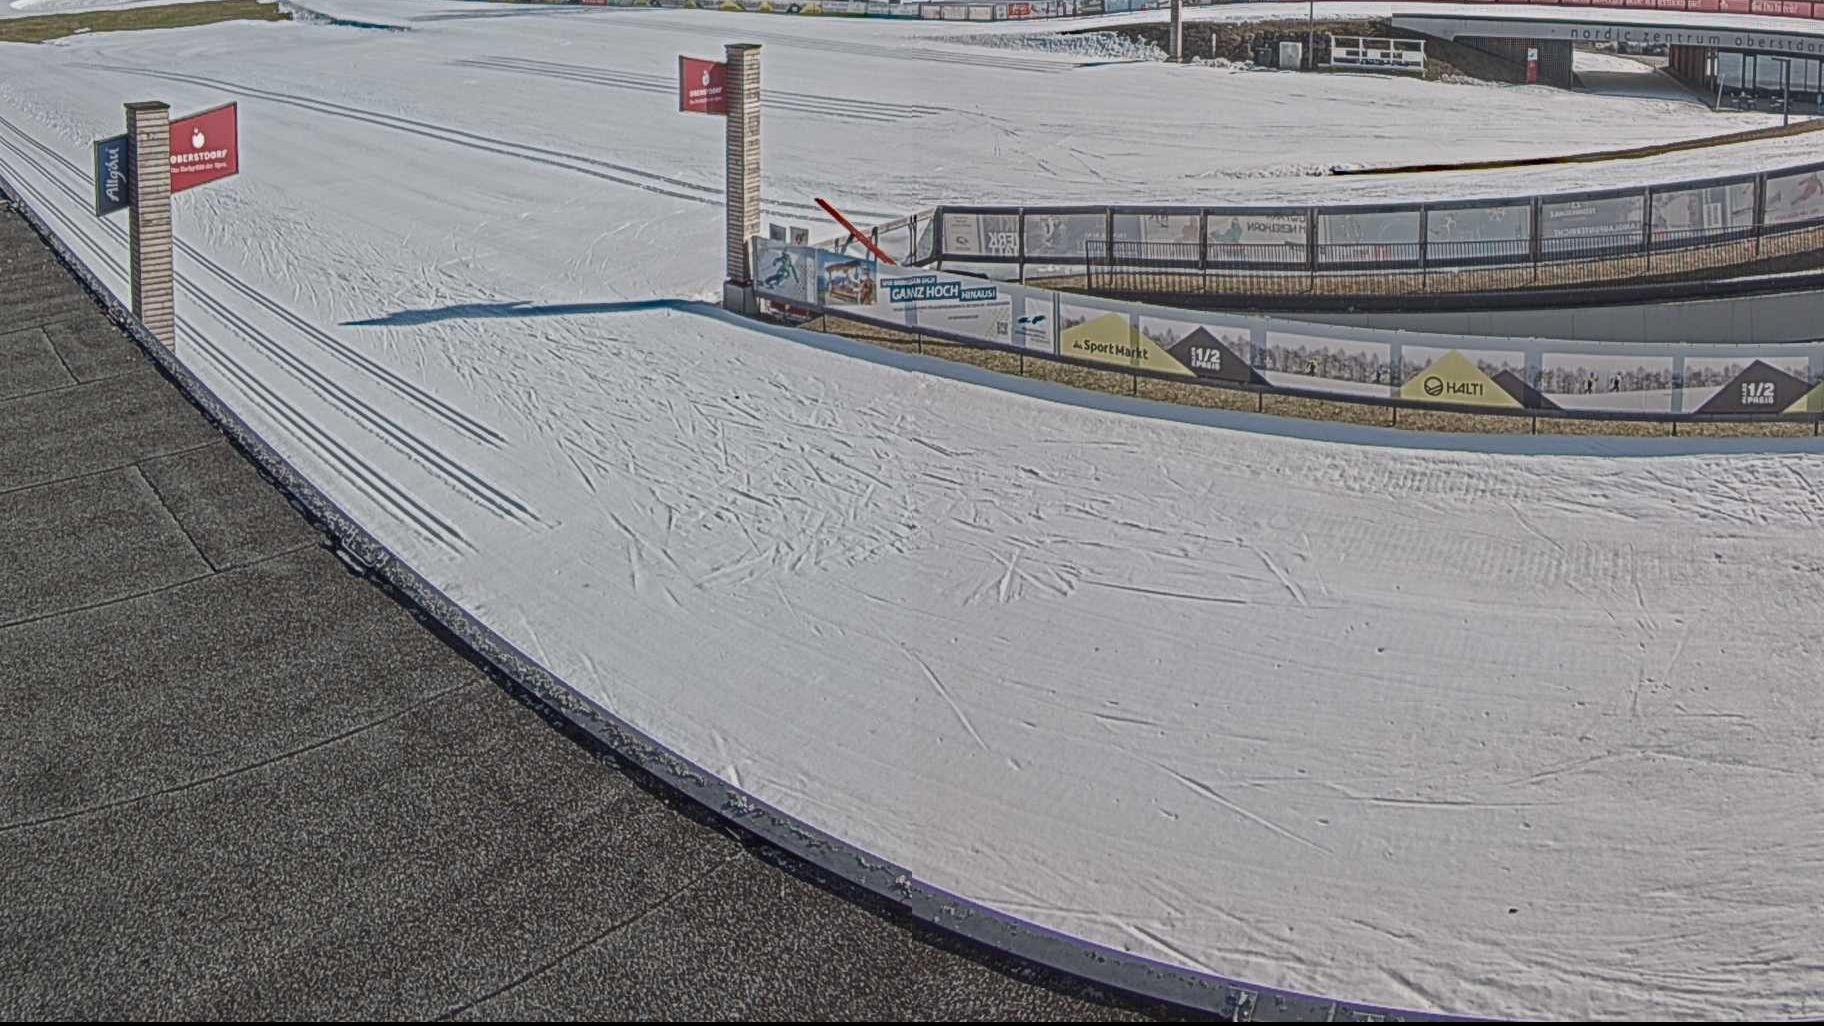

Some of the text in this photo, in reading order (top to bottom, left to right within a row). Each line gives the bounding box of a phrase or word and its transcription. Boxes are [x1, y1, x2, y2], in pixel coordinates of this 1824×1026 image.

[1571, 27, 1631, 41] nordic
[1643, 31, 1721, 45] zentrum
[170, 149, 227, 164] OBERSTDORF
[892, 285, 924, 300] GANZ
[926, 284, 958, 298] HOCH
[1083, 339, 1149, 360] Sport Markt
[1196, 348, 1220, 363] 1/2
[1446, 381, 1484, 396] HALTI
[1748, 382, 1775, 396] 1/2
